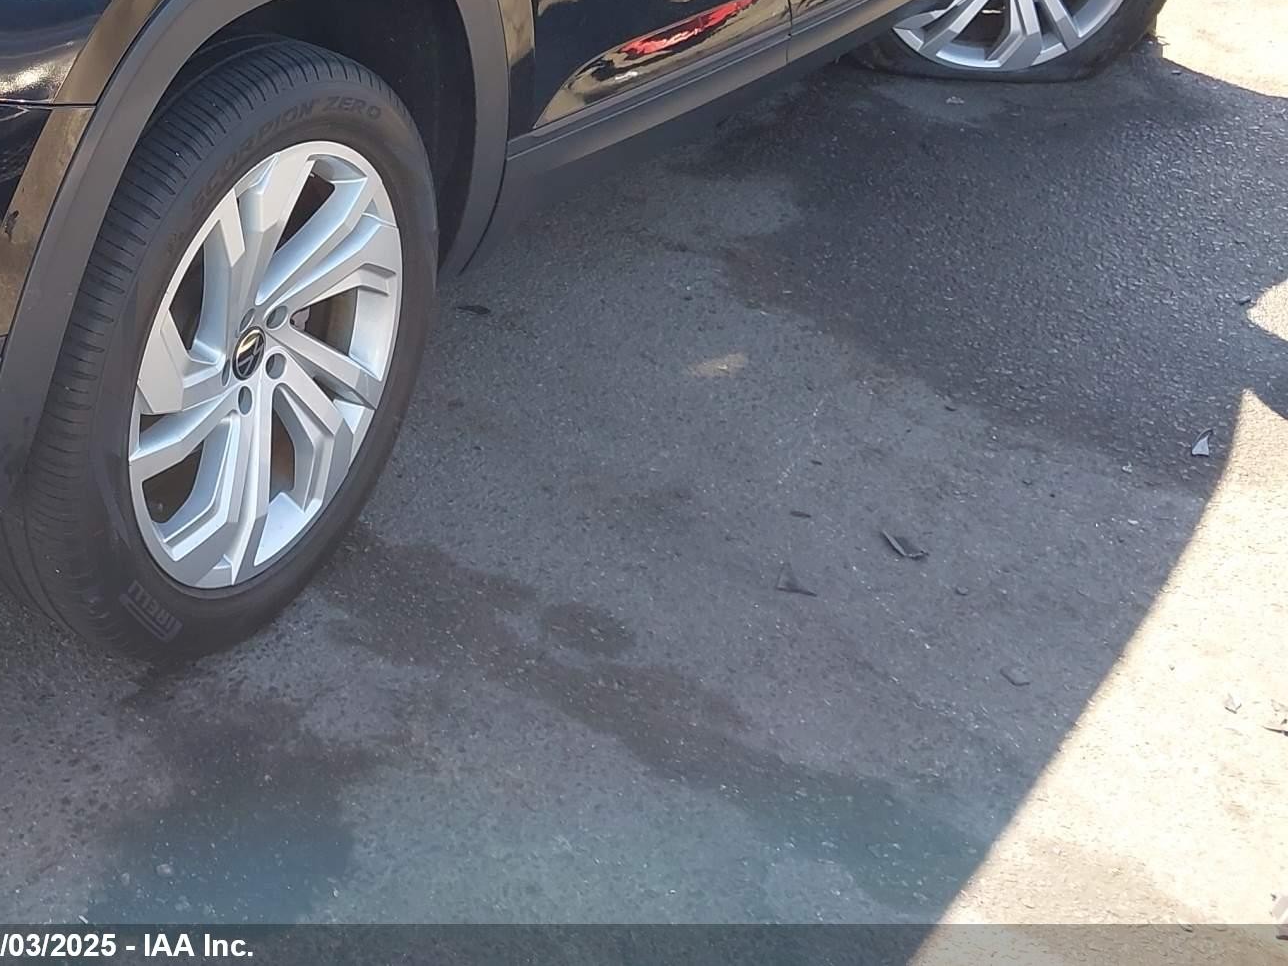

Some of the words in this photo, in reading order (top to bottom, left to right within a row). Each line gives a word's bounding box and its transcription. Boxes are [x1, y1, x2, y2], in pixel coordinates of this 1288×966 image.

[191, 98, 316, 216] SCORPION
[322, 95, 381, 120] ZERO
[118, 579, 183, 642] PIRELLI
